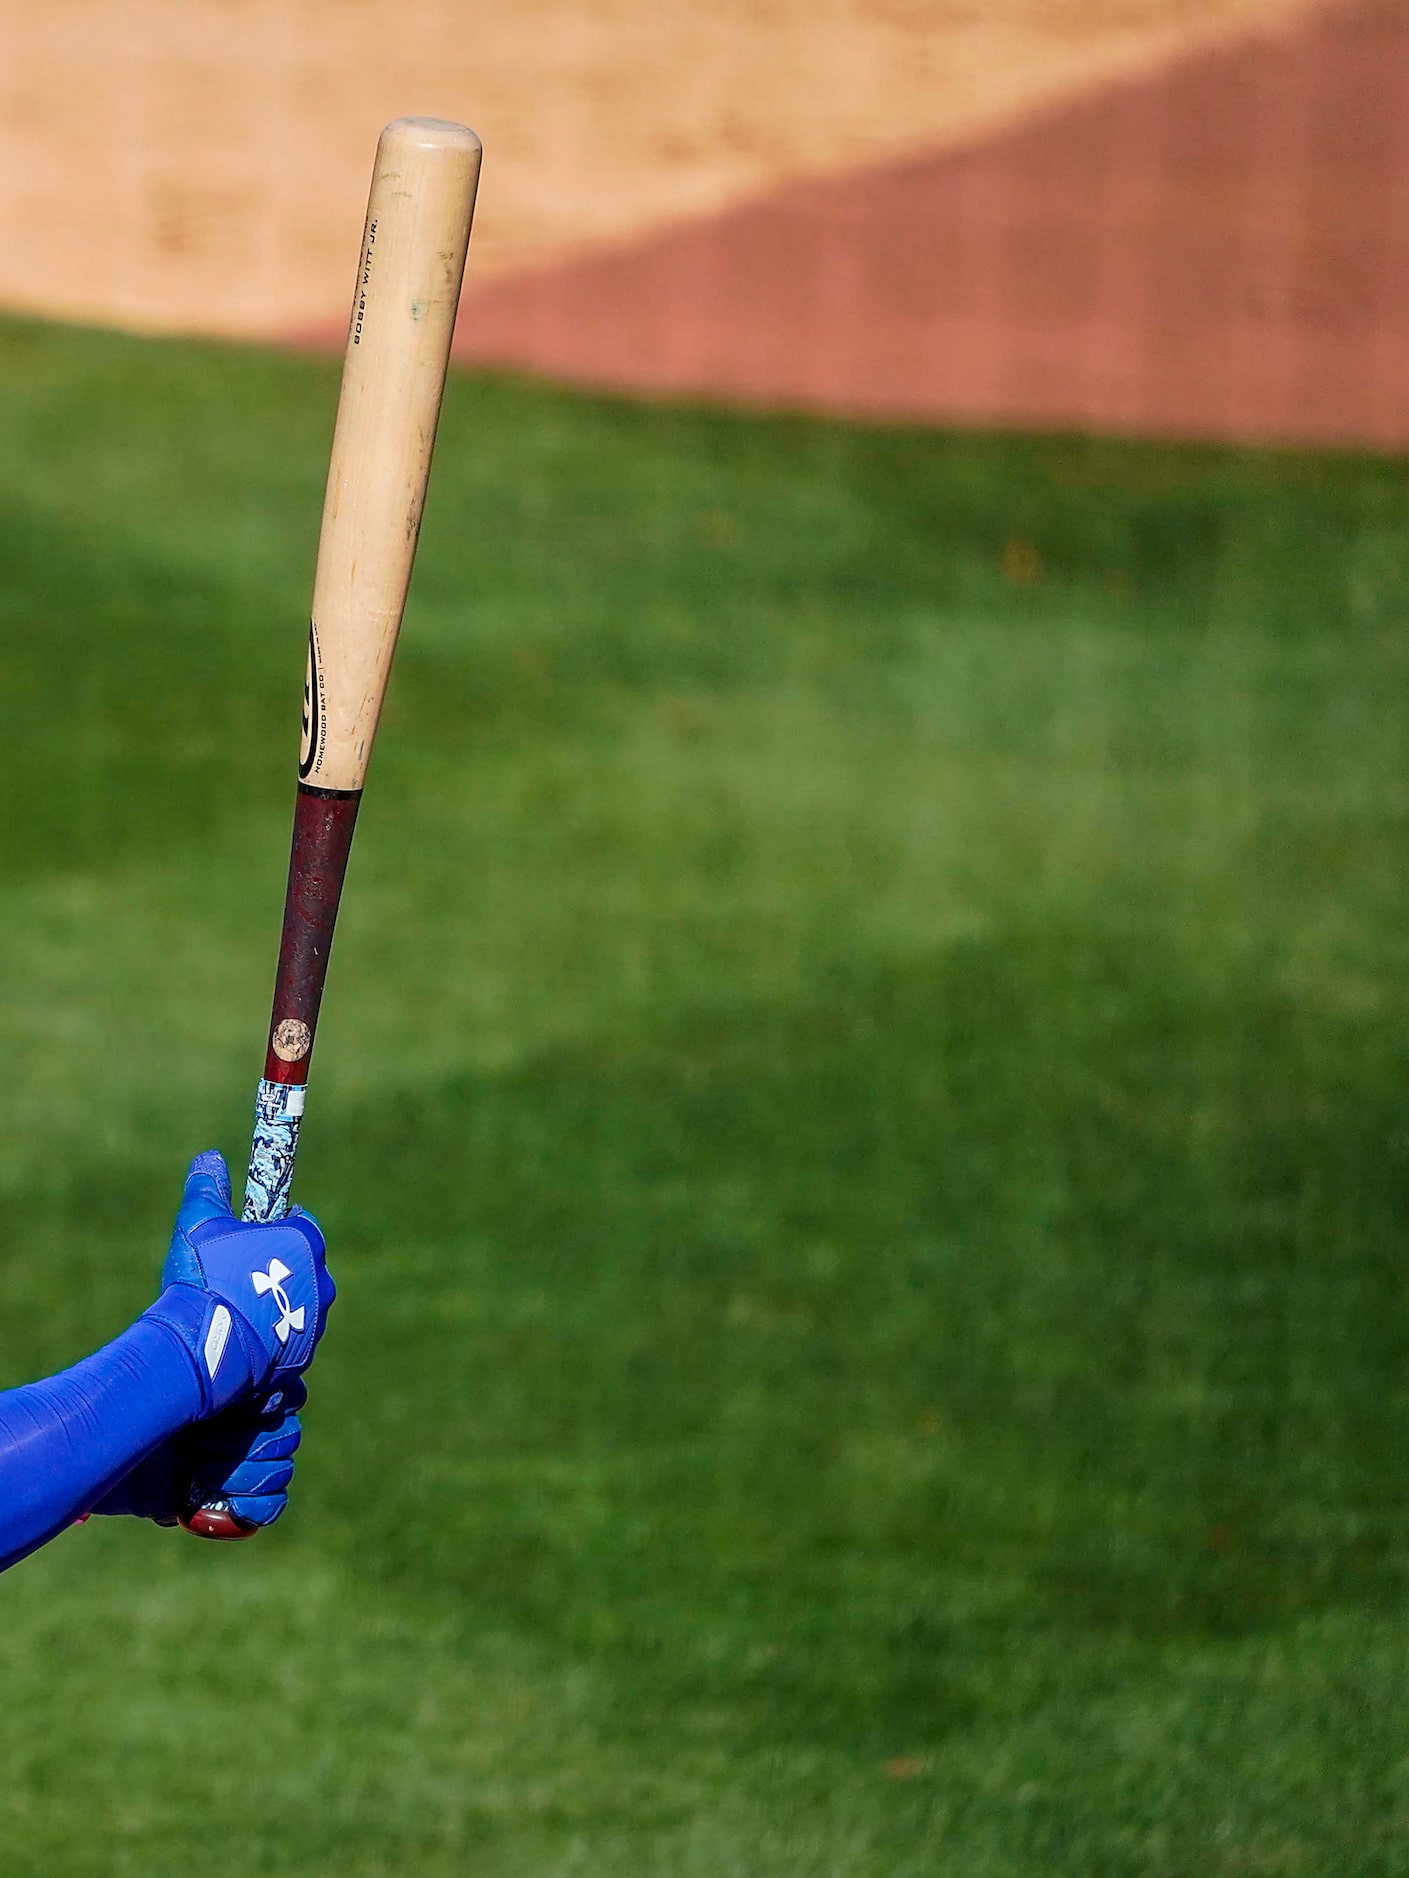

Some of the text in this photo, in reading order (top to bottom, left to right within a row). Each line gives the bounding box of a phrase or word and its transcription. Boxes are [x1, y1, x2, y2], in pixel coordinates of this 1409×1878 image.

[354, 290, 367, 345] BOBBY
[362, 248, 373, 284] WITT
[369, 219, 378, 244] JR.
[318, 674, 325, 689] CO
[315, 714, 328, 774] HOMEWOOD
